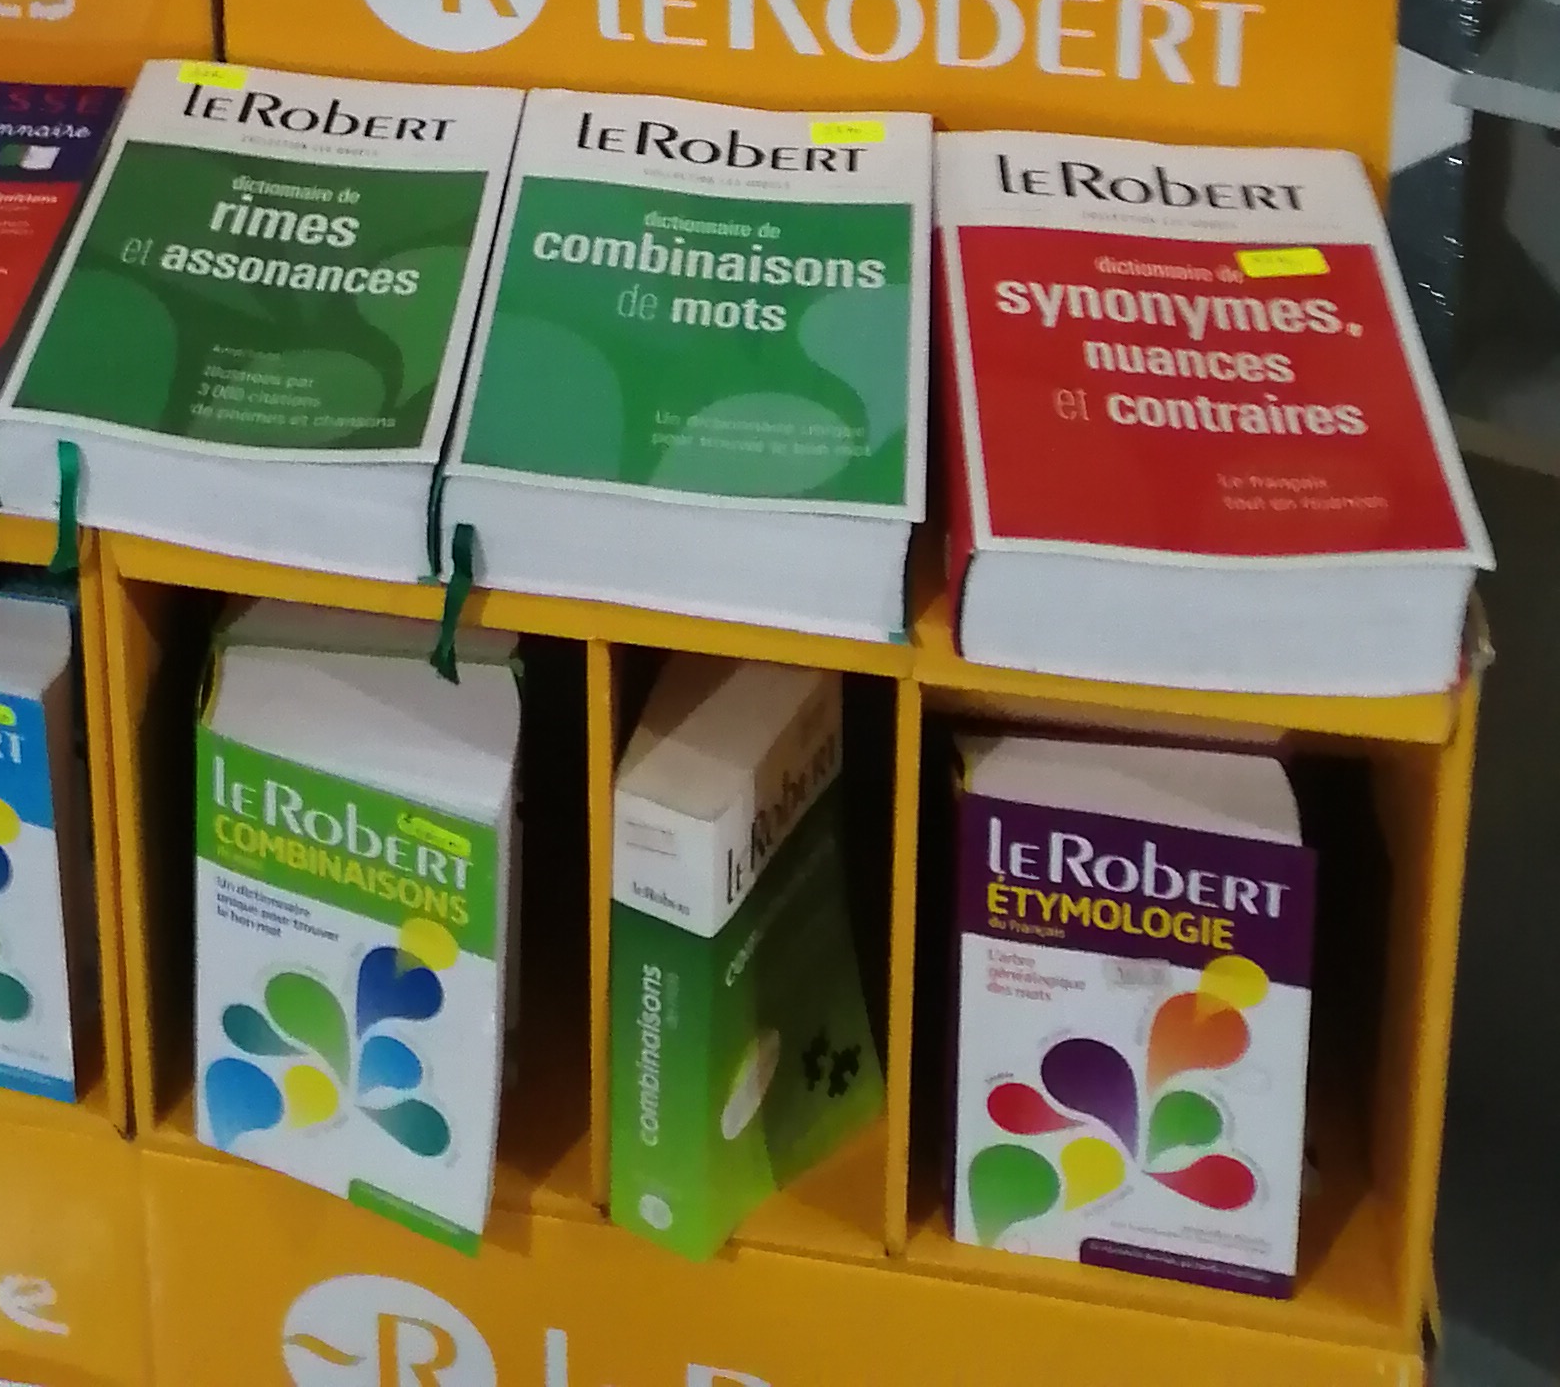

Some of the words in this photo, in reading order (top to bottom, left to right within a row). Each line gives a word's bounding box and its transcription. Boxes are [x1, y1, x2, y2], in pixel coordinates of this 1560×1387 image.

[232, 173, 335, 204] dictionnaire
[338, 185, 362, 205] de
[209, 193, 361, 249] rimes
[643, 209, 753, 239] dictionnaire
[757, 220, 782, 240] de
[120, 235, 152, 268] et
[160, 240, 422, 298] assonances
[533, 230, 888, 291] combinaisons
[1094, 255, 1215, 283] dictionnaire
[616, 282, 660, 321] de
[669, 293, 788, 332] mots
[1083, 337, 1297, 384] nuances
[1053, 387, 1091, 422] et
[1105, 392, 1370, 437] contraires
[214, 812, 472, 929] COMBINAISONS
[986, 875, 1237, 952] ÉTYMOLOGIE
[639, 963, 664, 1147] combinaisons
